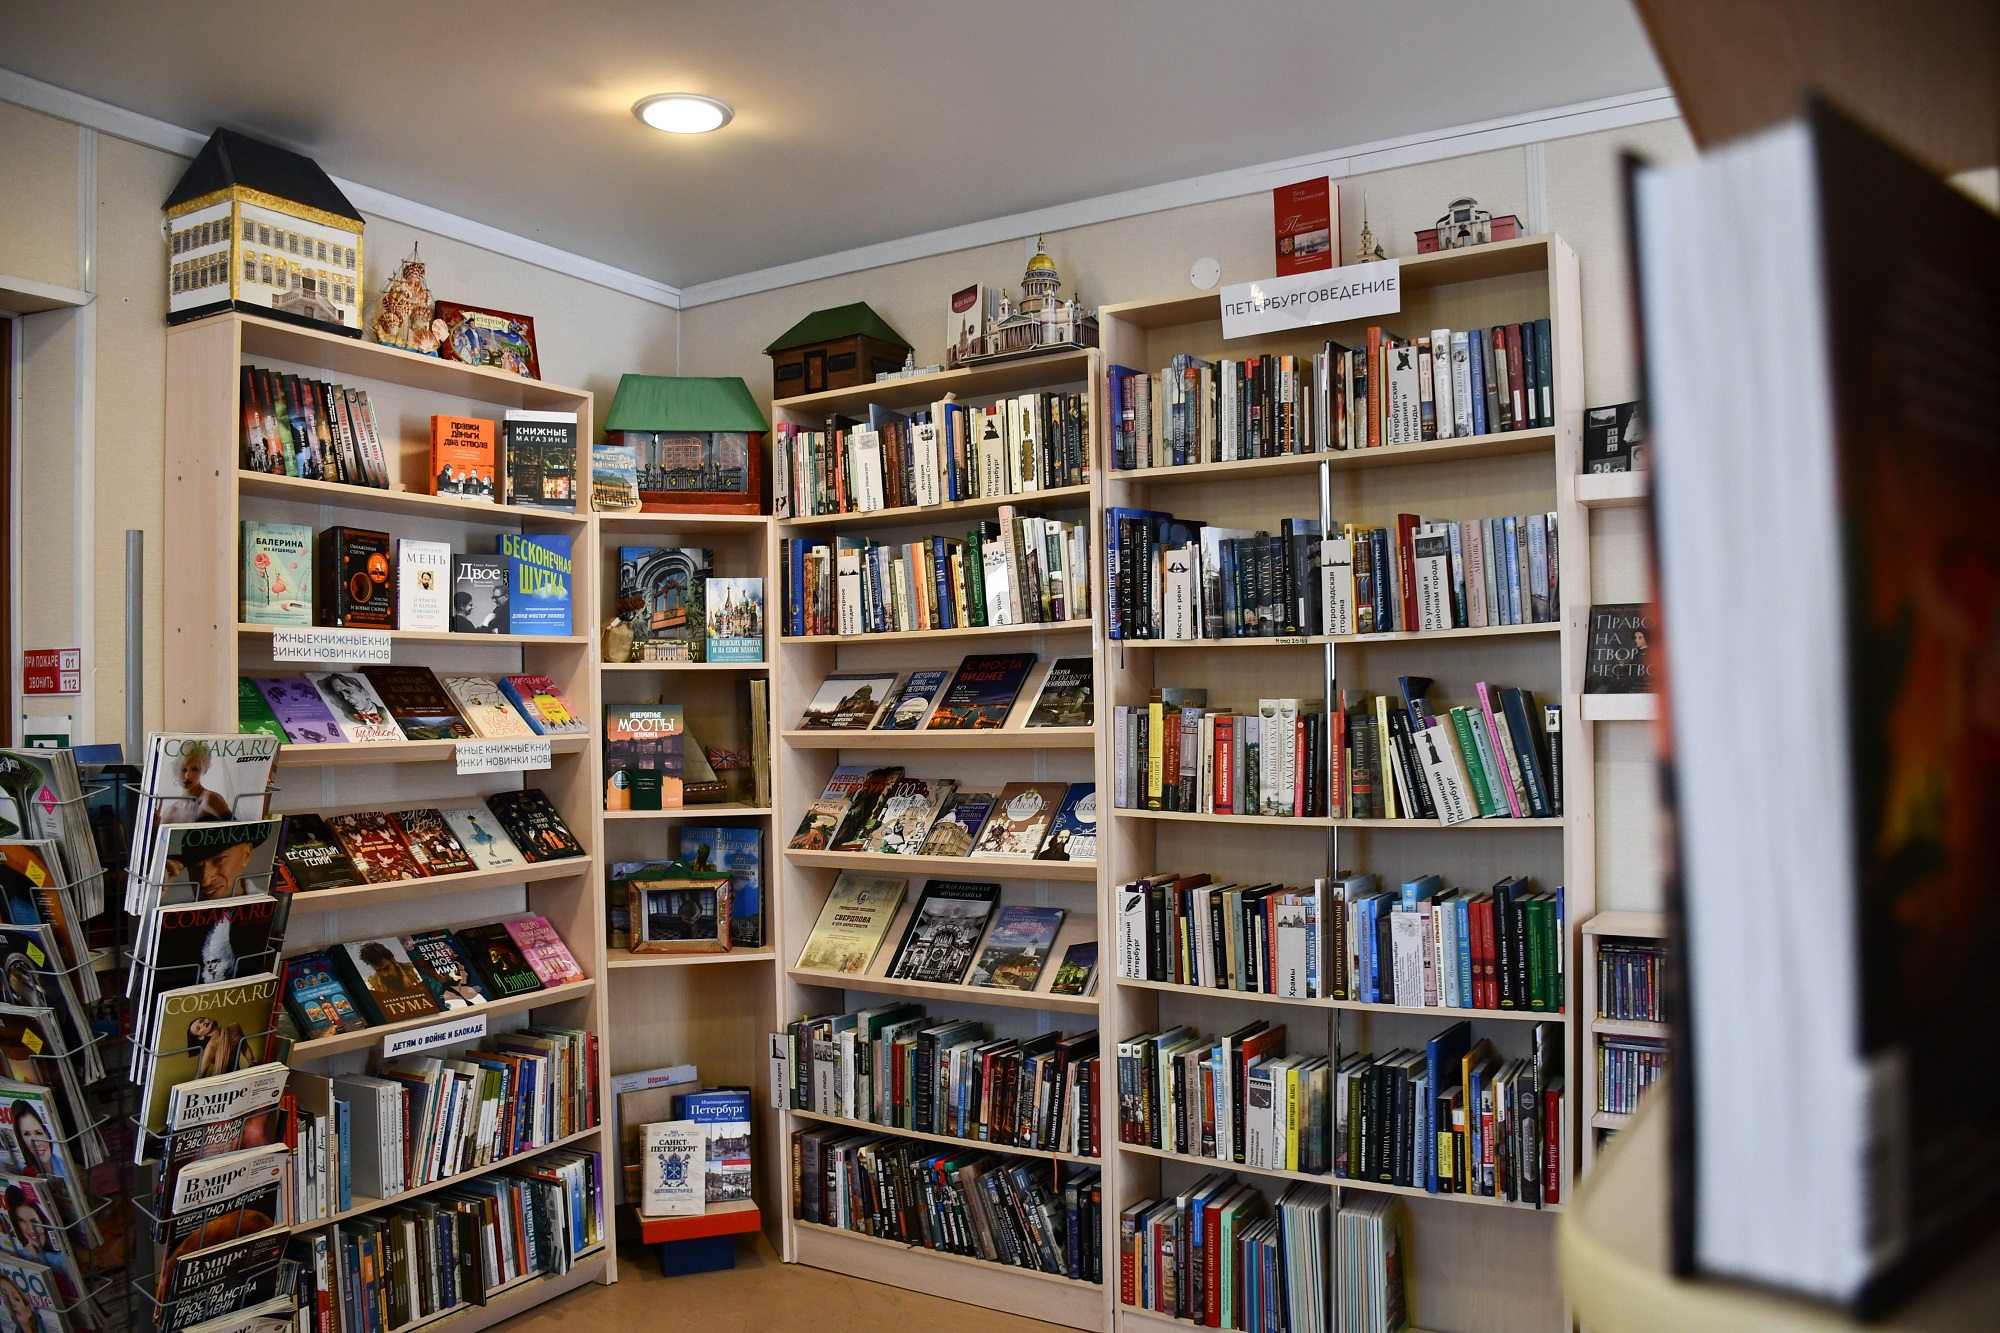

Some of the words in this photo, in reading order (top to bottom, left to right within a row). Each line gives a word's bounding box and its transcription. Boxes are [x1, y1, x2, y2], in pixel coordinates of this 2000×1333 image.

[1391, 380, 1401, 443] Петербургские
[1402, 401, 1411, 442] предания
[1412, 404, 1420, 441] легенды
[516, 427, 567, 437] КНИЖНЫЕ
[516, 436, 568, 444] МАГАЗИНЫ
[256, 537, 304, 548] БАЛЕРИНА
[406, 553, 446, 565] МЕНЬ
[503, 534, 572, 575] БЕСКОНЕЧНАЯ
[1472, 537, 1481, 574] ЛИГОВКА
[457, 563, 501, 583] Двое
[519, 563, 566, 597] ШУТКА
[1431, 559, 1440, 589] города
[1175, 584, 1183, 603] реки
[1328, 571, 1338, 634] Петроградская
[1423, 583, 1432, 616] улицам
[1433, 591, 1442, 629] районам
[1425, 617, 1432, 629] По
[1596, 615, 1656, 631] ПРАВО
[1595, 632, 1621, 645] НА
[25, 655, 36, 668] ПРИ
[36, 654, 59, 667] ПОЖАРЕ
[65, 658, 75, 668] 01
[314, 648, 367, 659] НОВИНКИ
[1593, 648, 1646, 661] ТВОР-
[967, 661, 977, 671] С
[979, 660, 1023, 671] МОСТА
[28, 676, 54, 689] ЗВОНИТЬ
[64, 679, 77, 689] 112
[960, 671, 1006, 682] ВИДНЕЕ
[1269, 719, 1277, 743] ОХТА
[1285, 719, 1294, 748] ОХТА
[164, 739, 277, 758] СОБАКА.RU
[485, 744, 529, 754] КНИЖНЫЕ
[486, 757, 529, 766] НОВИНКИ
[1269, 745, 1277, 790] БОЛЬШАЯ
[1286, 752, 1294, 790] МАЛАЯ
[895, 782, 916, 798] 100
[1433, 771, 1455, 824] Пушкинский
[1446, 776, 1466, 821] Петербург
[297, 846, 340, 858] СКРЫТЫЙ
[304, 856, 332, 867] ГЕНИЙ
[163, 902, 276, 930] СОБАКА.RU
[834, 914, 871, 924] СВЕРДЛОВА
[419, 942, 446, 953] ВЕТЕР
[421, 949, 453, 961] ЗНАЕТ
[435, 965, 458, 976] ИМЯ
[1460, 951, 1470, 1002] КРОНШТАДТ
[1288, 968, 1296, 997] Храмы
[165, 981, 277, 1015] СОБАКА.RU
[385, 999, 434, 1015] ТУМА
[392, 1039, 416, 1052] ДЕТЯМ
[418, 1037, 423, 1045] О
[425, 1032, 446, 1045] ВОЙНЕ
[448, 1031, 453, 1039] И
[454, 1024, 483, 1038] БЛОКАДЕ
[647, 1075, 669, 1084] Образы
[185, 1093, 200, 1109] В
[202, 1087, 248, 1105] мире
[182, 1102, 226, 1121] науки
[691, 1105, 745, 1117] Петербург
[175, 1144, 182, 1153] В
[185, 1178, 199, 1194] В
[203, 1166, 247, 1186] мире
[182, 1184, 225, 1204] науки
[226, 1201, 234, 1212] К
[185, 1260, 199, 1276] В
[203, 1247, 248, 1267] мире
[183, 1266, 225, 1288] науки
[172, 1318, 182, 1329] И
